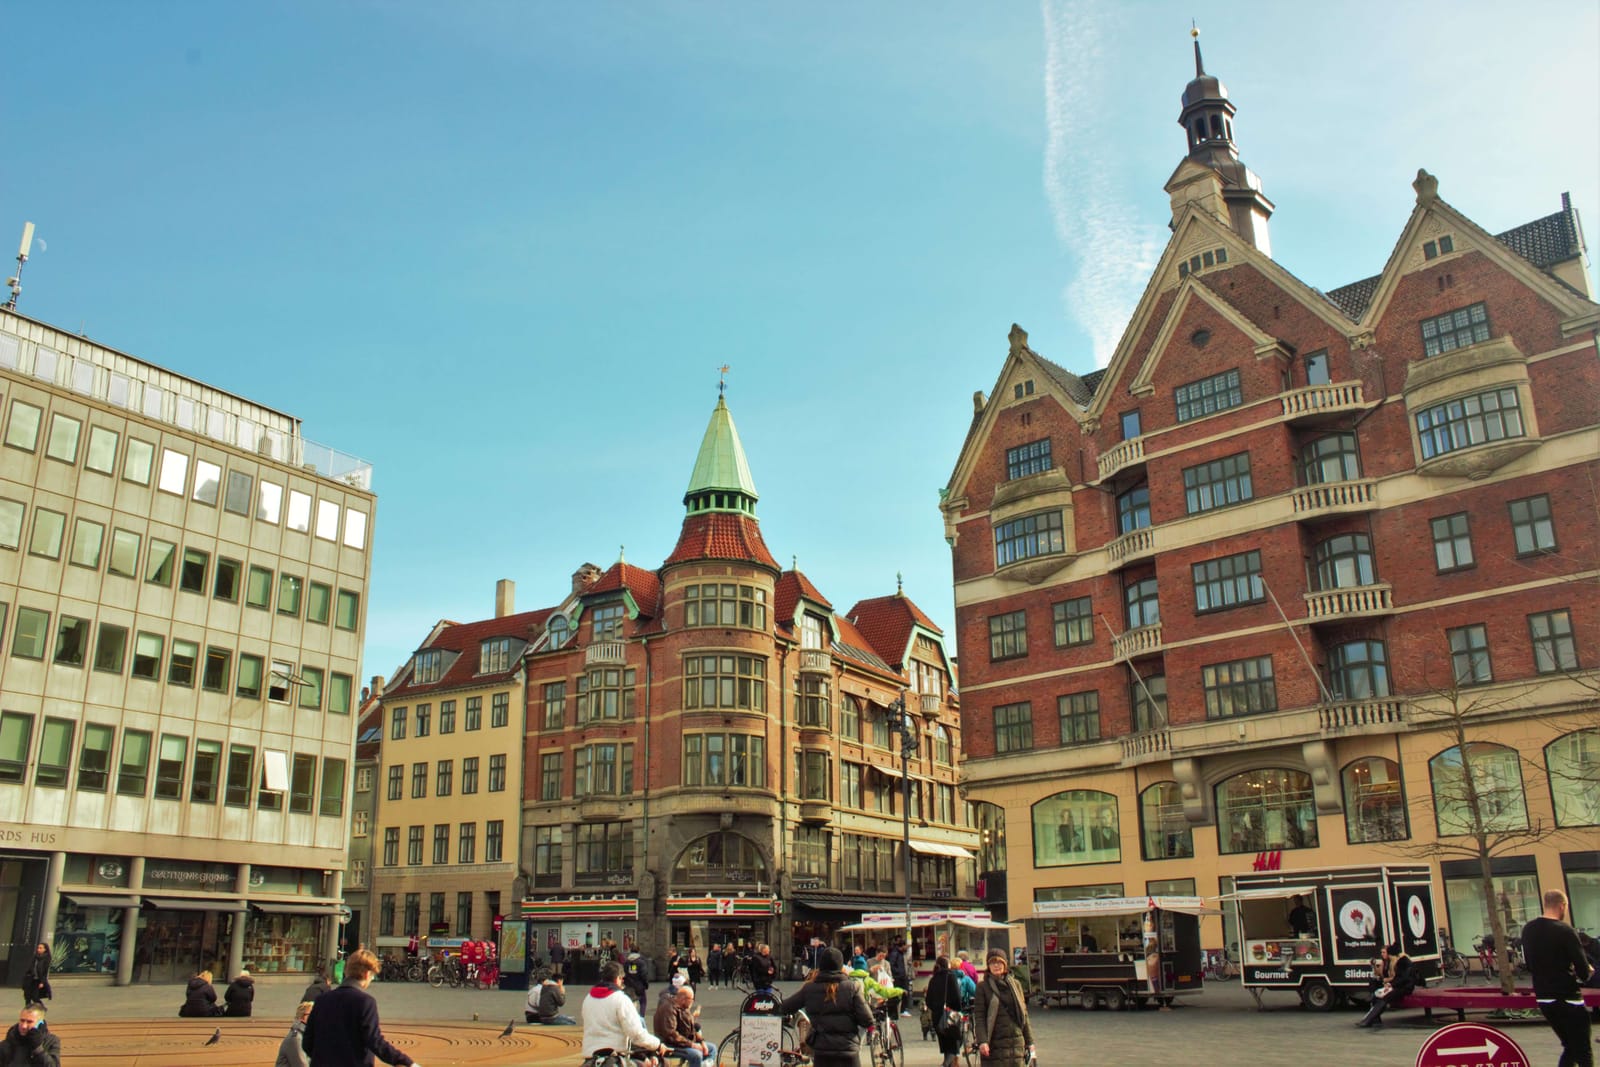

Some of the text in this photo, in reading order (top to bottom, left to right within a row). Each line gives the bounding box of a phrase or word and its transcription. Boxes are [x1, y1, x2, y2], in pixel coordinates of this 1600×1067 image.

[30, 833, 56, 844] HUS
[1252, 851, 1282, 872] H&M
[1255, 970, 1289, 980] Gourmet
